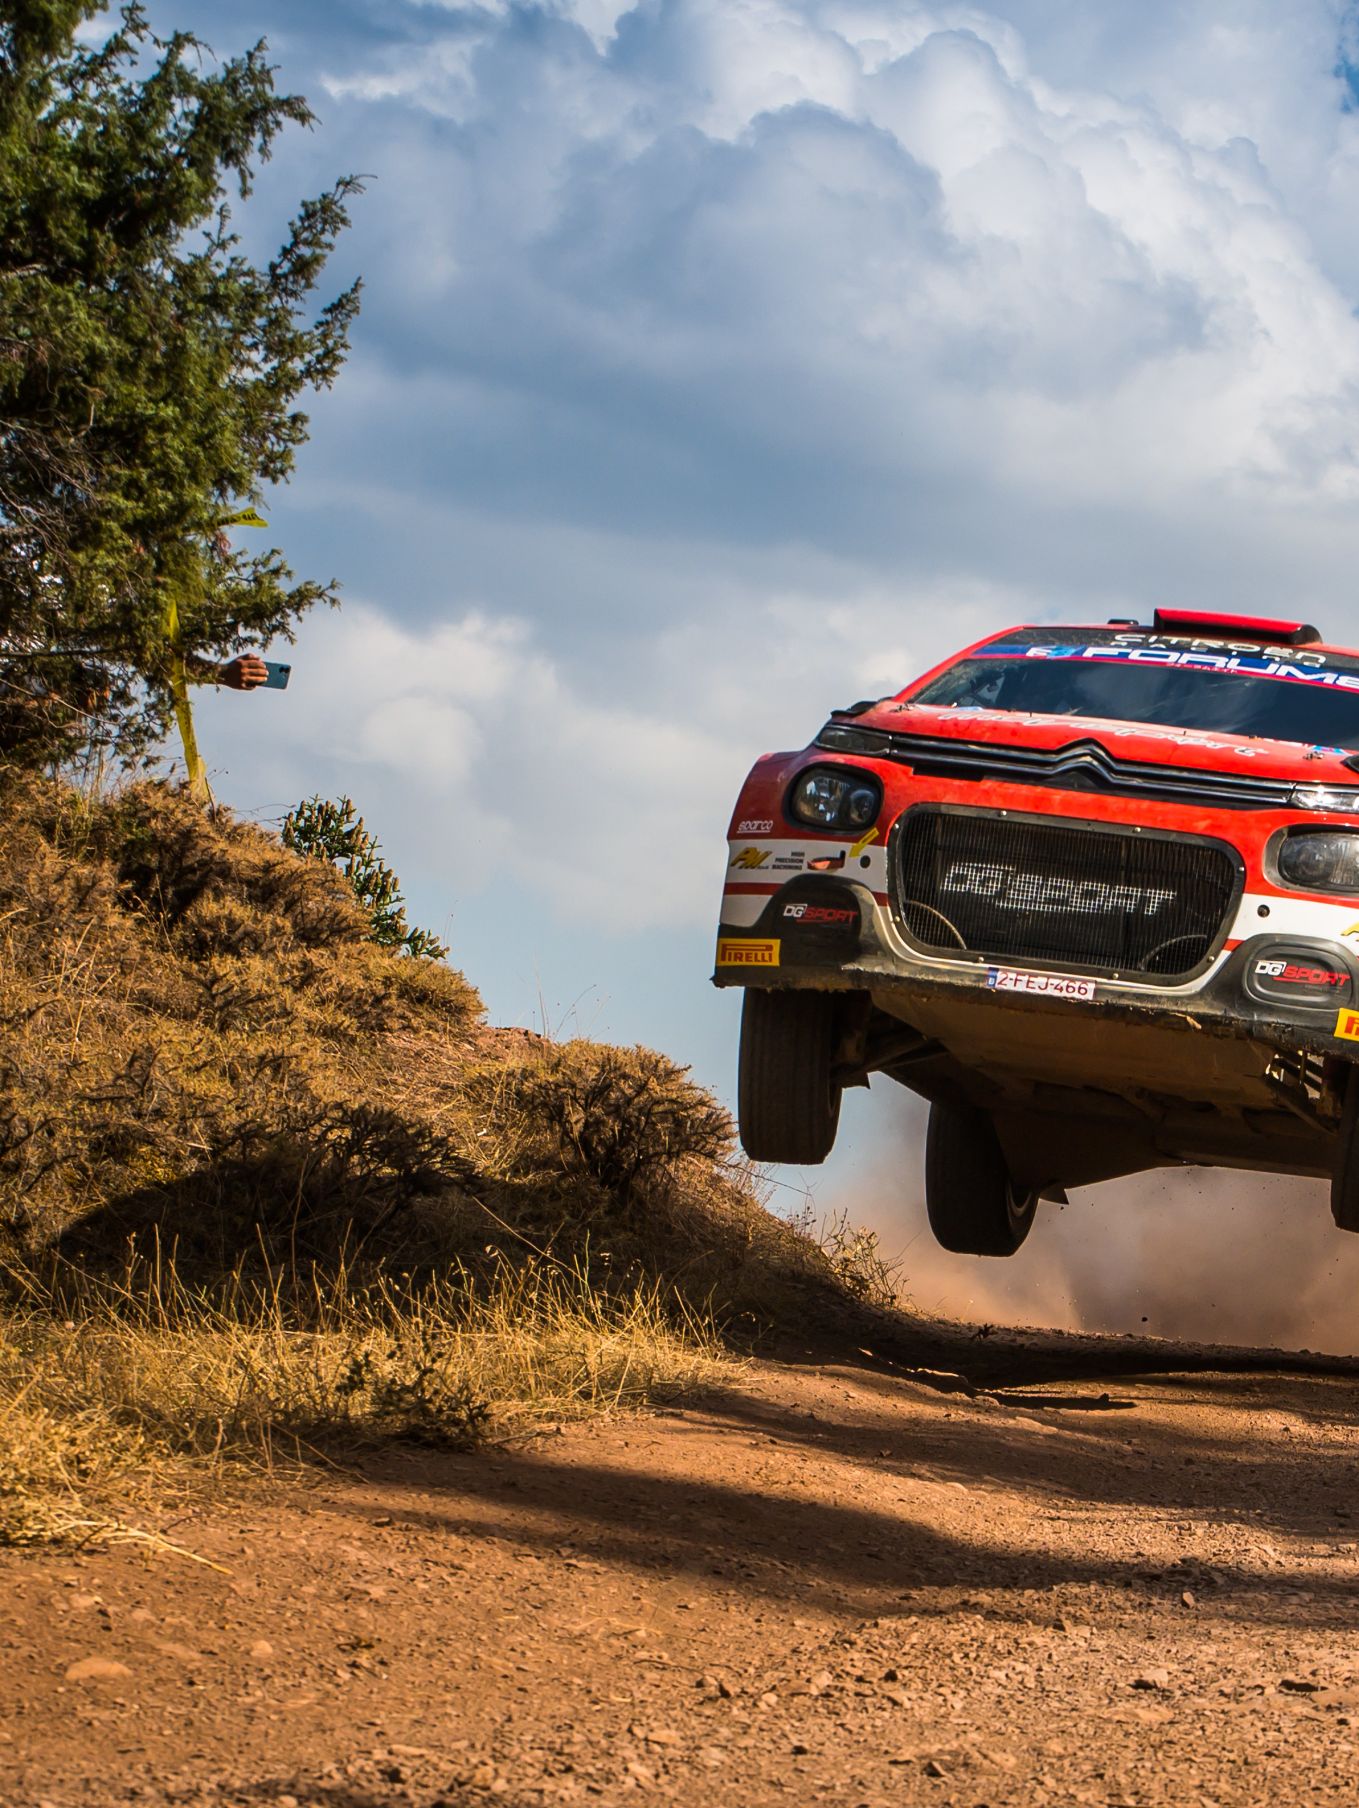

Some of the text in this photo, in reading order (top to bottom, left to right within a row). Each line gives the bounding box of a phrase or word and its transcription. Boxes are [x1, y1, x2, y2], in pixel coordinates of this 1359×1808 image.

[738, 820, 774, 832] sparco
[720, 943, 774, 963] PIRELLI
[997, 971, 1088, 996] 2-FEJ-466
